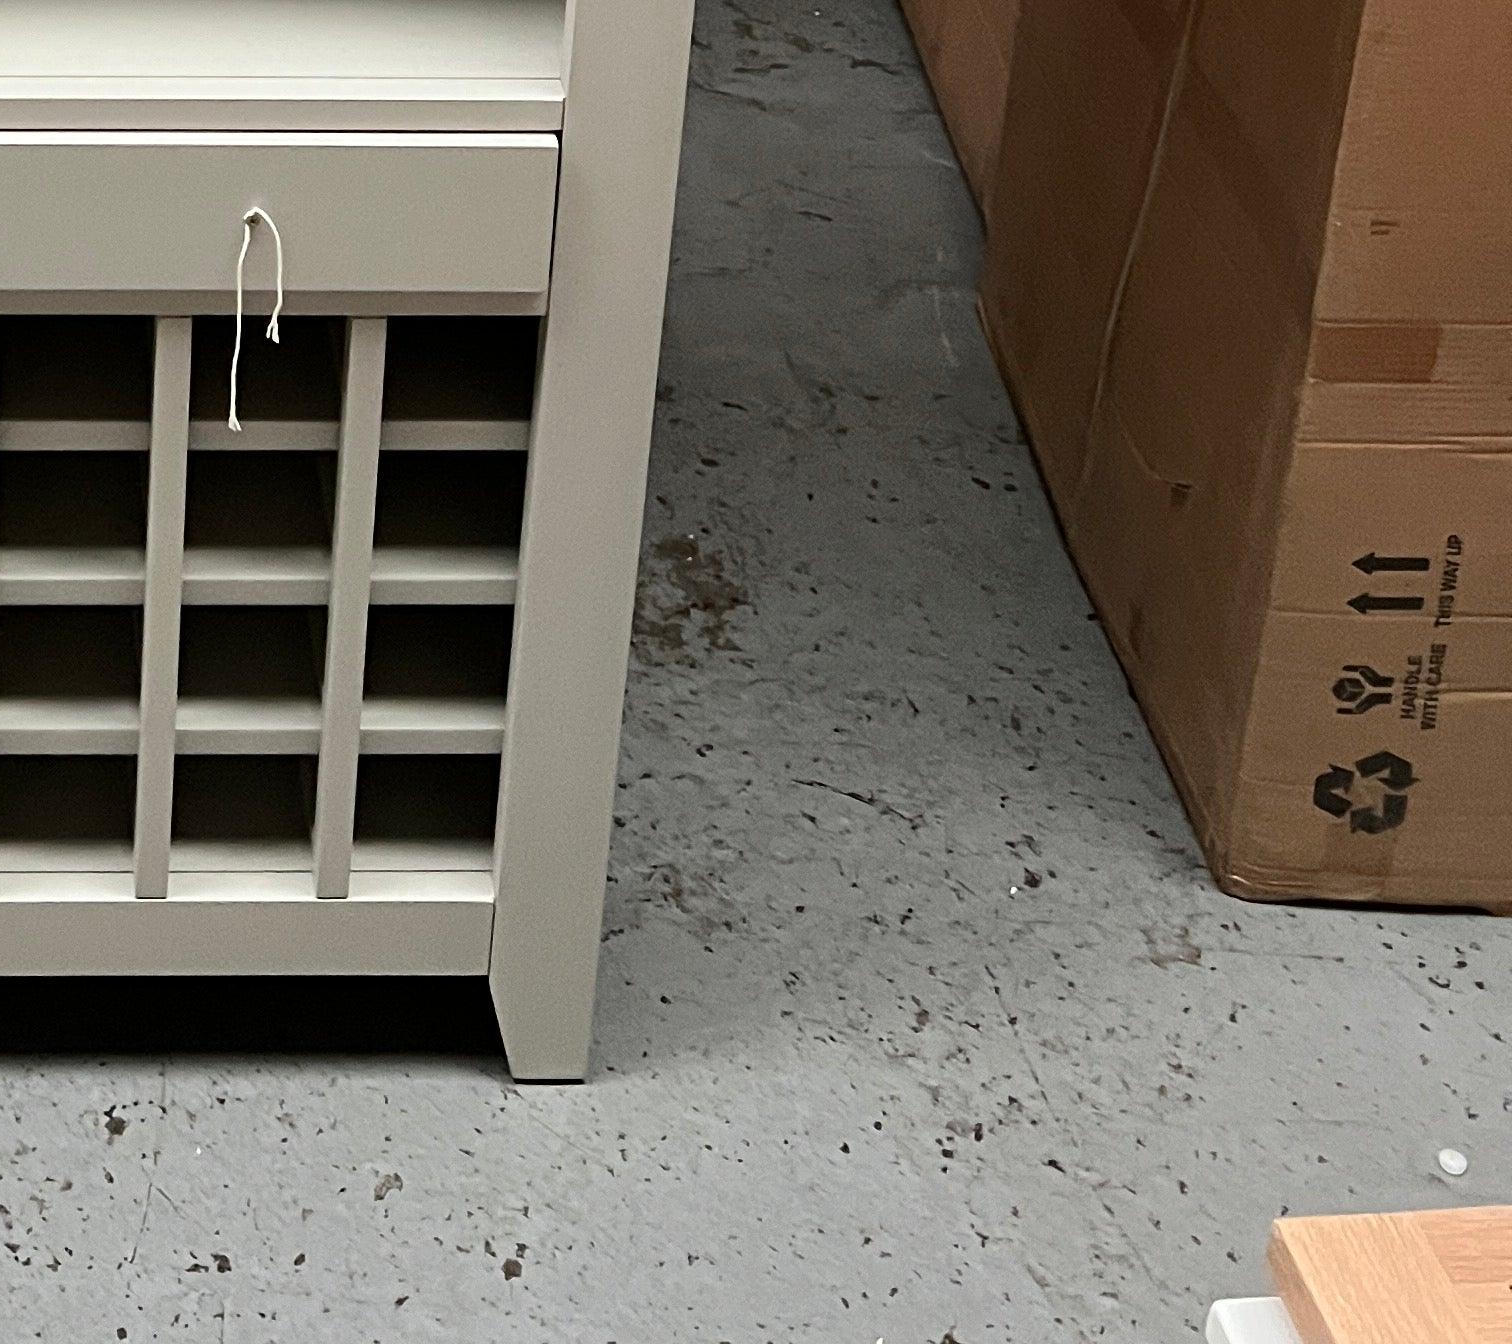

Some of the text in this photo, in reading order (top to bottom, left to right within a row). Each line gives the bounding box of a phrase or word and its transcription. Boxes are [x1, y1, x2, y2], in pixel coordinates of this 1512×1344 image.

[1434, 534, 1464, 627] THIS WAY UP
[1400, 655, 1422, 719] HANDLE
[1420, 644, 1447, 730] WITH CARE
